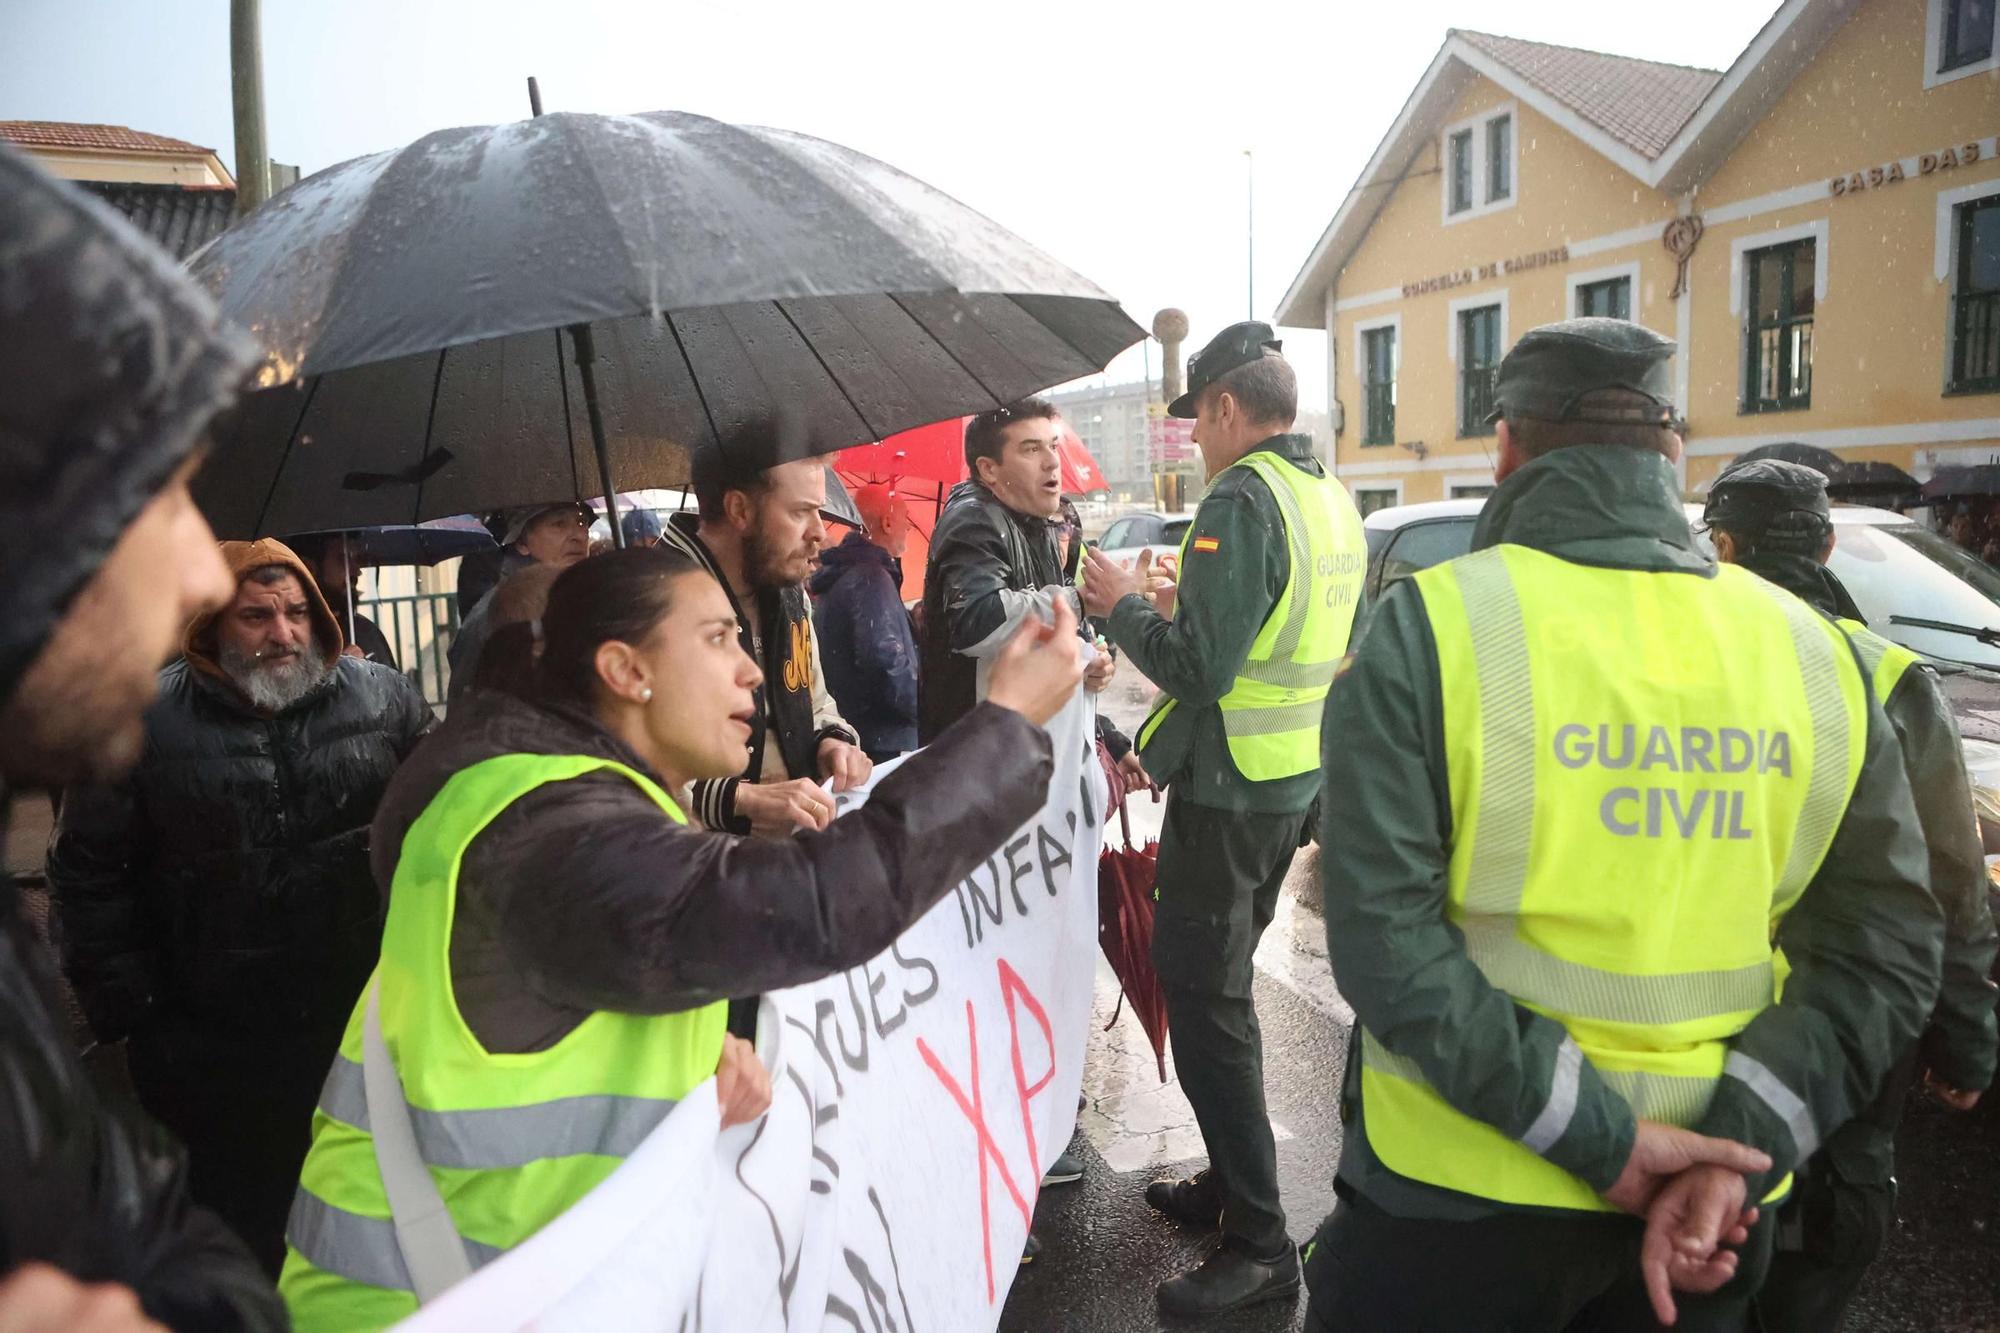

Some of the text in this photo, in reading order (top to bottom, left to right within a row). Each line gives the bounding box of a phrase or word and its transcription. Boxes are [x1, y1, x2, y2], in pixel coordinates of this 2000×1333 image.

[1830, 162, 1904, 196] CASA
[1918, 142, 1980, 175] DAS
[1478, 262, 1498, 280] DE
[1317, 551, 1361, 577] GUARDIA
[1325, 583, 1352, 608] CIVIL
[1552, 723, 1793, 779] GUARDIA
[1599, 786, 1753, 840] CIVIL
